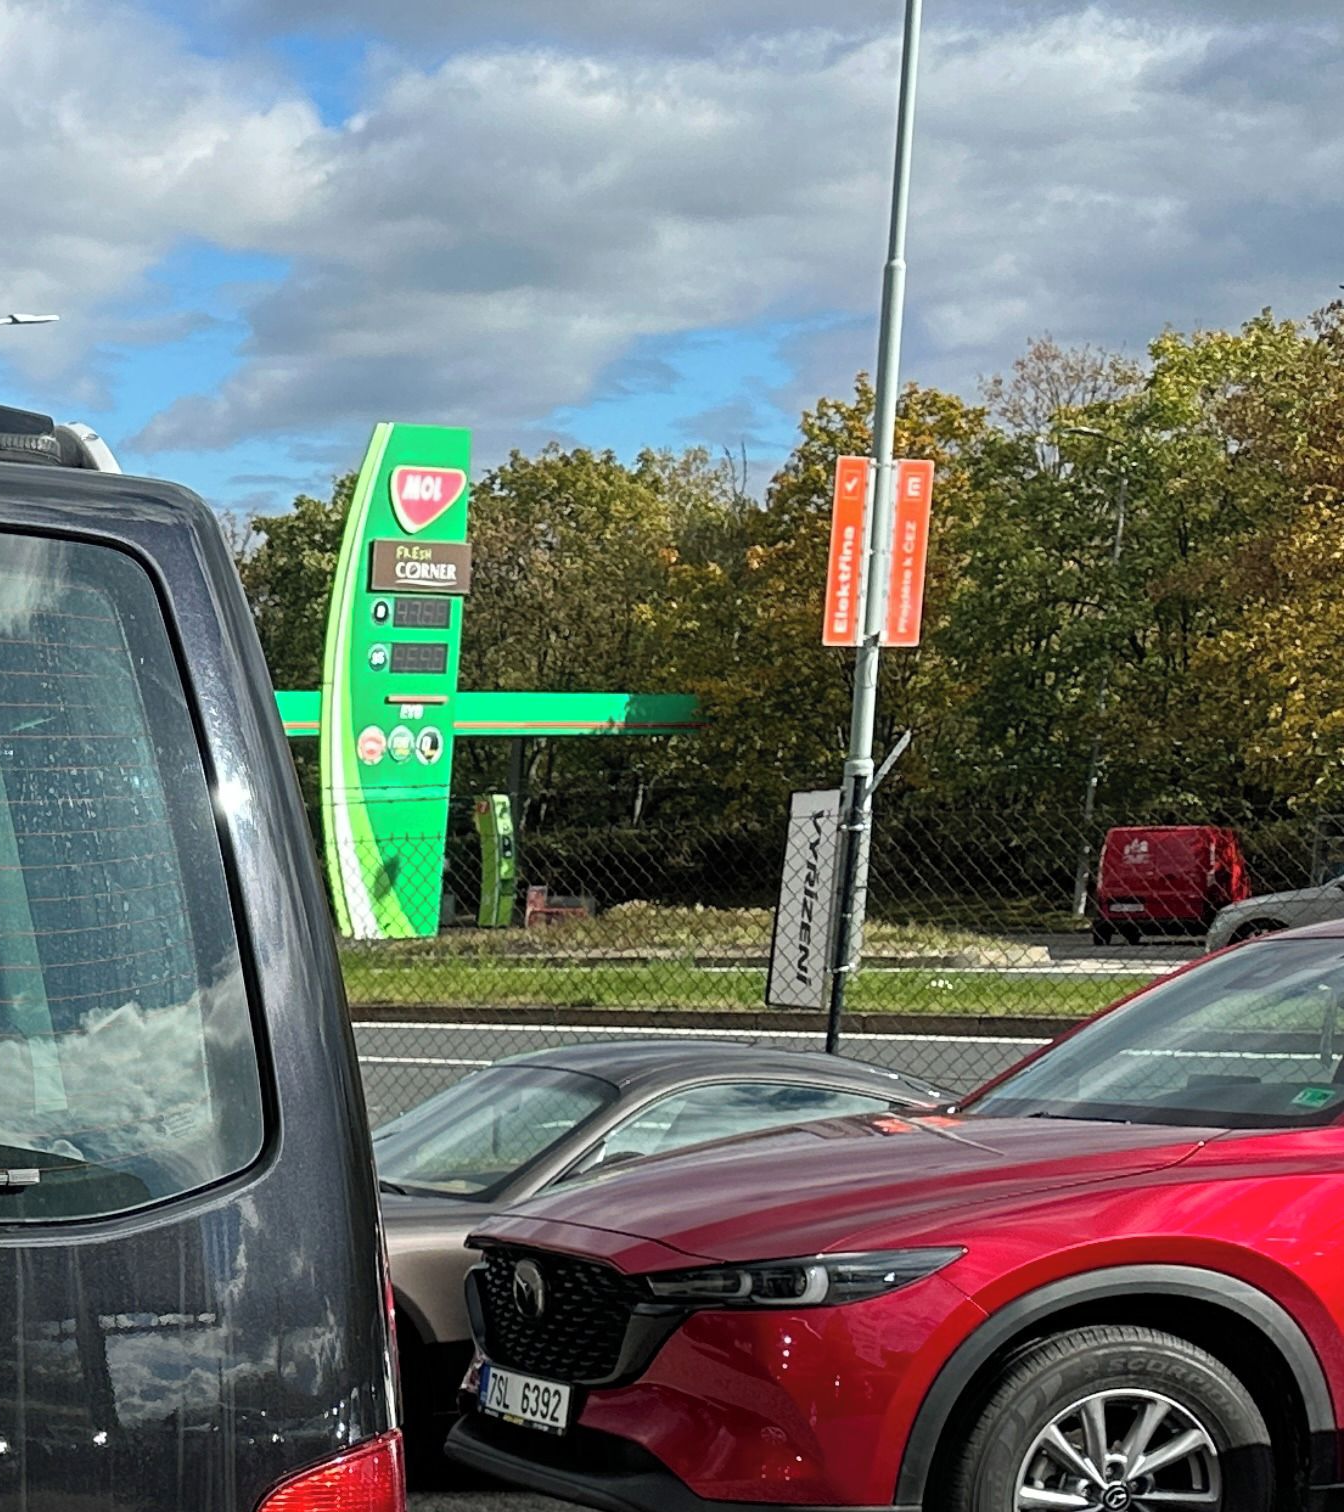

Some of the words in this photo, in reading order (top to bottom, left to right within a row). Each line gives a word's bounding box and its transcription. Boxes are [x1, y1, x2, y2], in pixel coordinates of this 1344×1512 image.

[401, 475, 444, 502] MOL
[396, 545, 432, 561] FRESH
[395, 561, 457, 580] CORNER
[489, 1372, 510, 1410] 7SL
[521, 1382, 562, 1423] 6392
